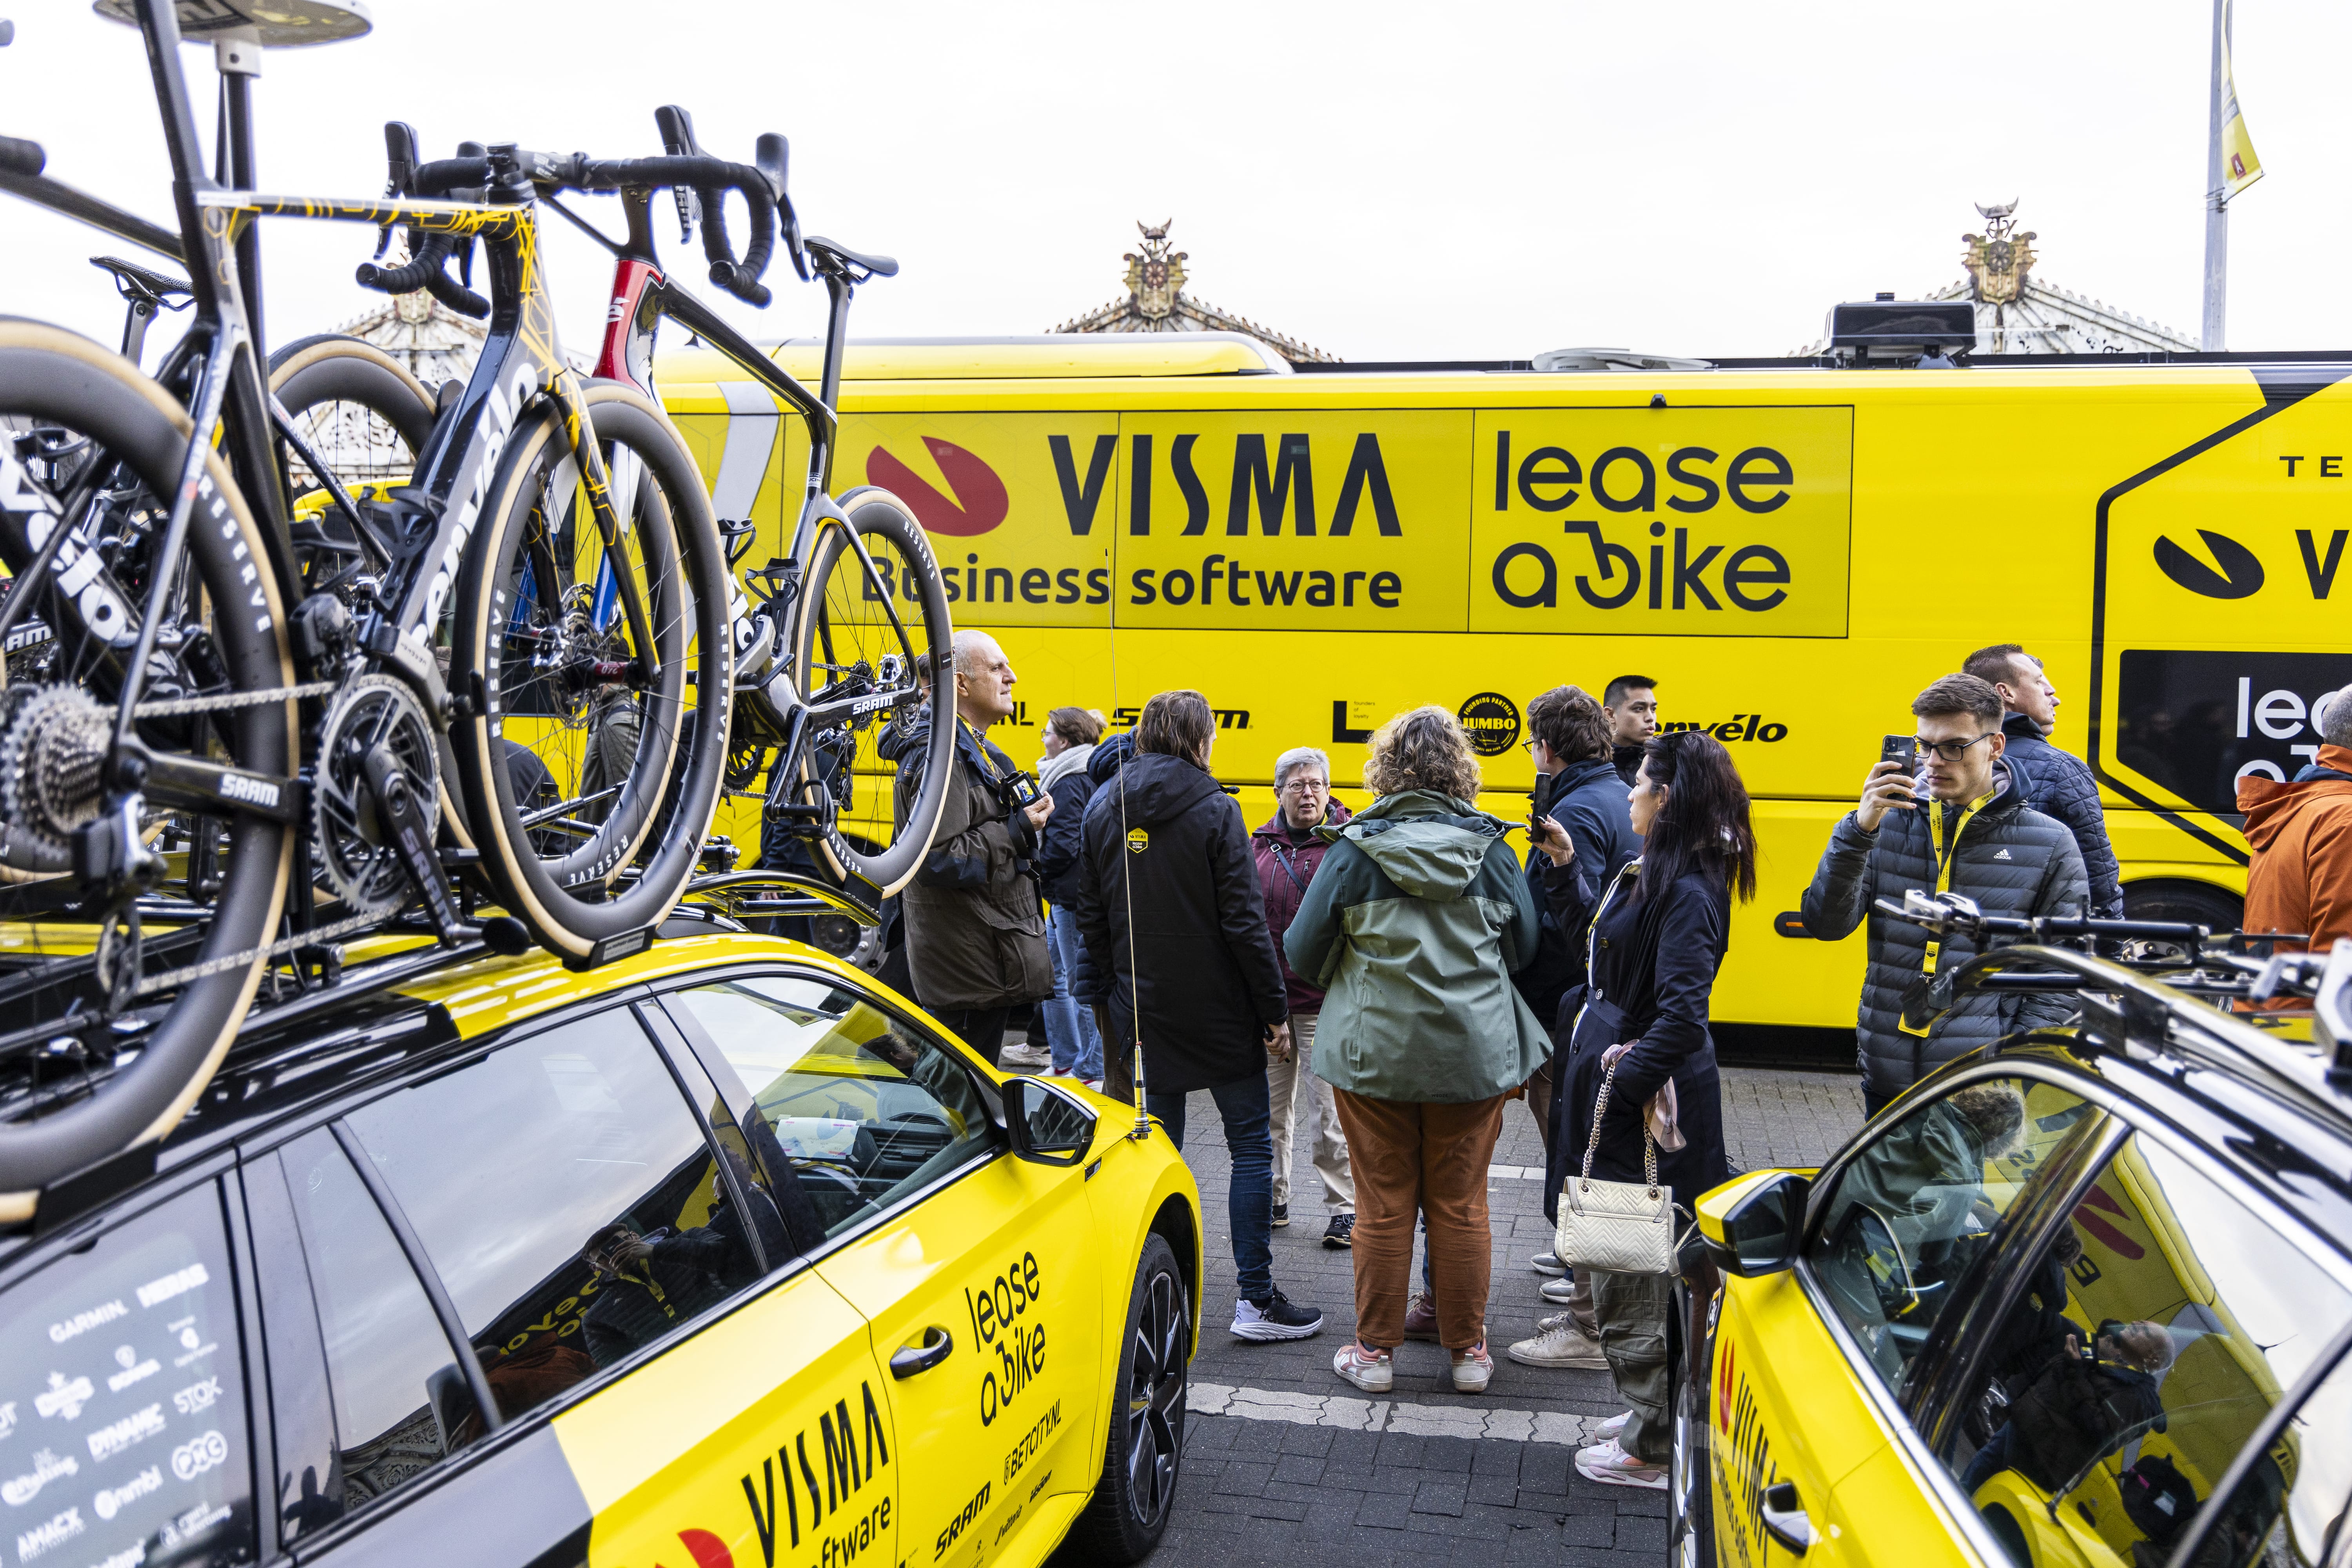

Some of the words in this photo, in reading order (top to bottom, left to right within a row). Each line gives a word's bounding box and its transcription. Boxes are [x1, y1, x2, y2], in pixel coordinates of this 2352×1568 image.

[1047, 433, 1403, 536] VISMA
[1495, 430, 1794, 513] lease
[2279, 456, 2343, 477] TE
[198, 474, 272, 632] RESERVE
[903, 520, 936, 581] RESERVE
[862, 554, 1109, 605] Business
[1131, 554, 1402, 608] software
[6, 625, 53, 652] AM
[490, 589, 506, 737] RESERVE
[717, 623, 729, 743] RESERVE
[852, 694, 893, 715] SRAM
[1463, 697, 1490, 715] FOUNDING
[1491, 697, 1514, 716] PARTNER
[1111, 708, 1250, 729] SM
[1461, 718, 1516, 730] JUMBO
[1655, 714, 1788, 742] rvélo
[220, 773, 280, 808] SRAM
[570, 834, 629, 885] RESERVE
[49, 1299, 129, 1343] GARMIN
[965, 1250, 1041, 1353] lease
[173, 1376, 223, 1414] STOX
[87, 1402, 165, 1459] DYNAMIC
[1010, 1398, 1062, 1479] BETCITY.NL
[740, 1379, 889, 1568] VISMA
[18, 1507, 84, 1555] AMACX
[811, 1495, 891, 1568] ftware
[934, 1480, 991, 1563] SRAM
